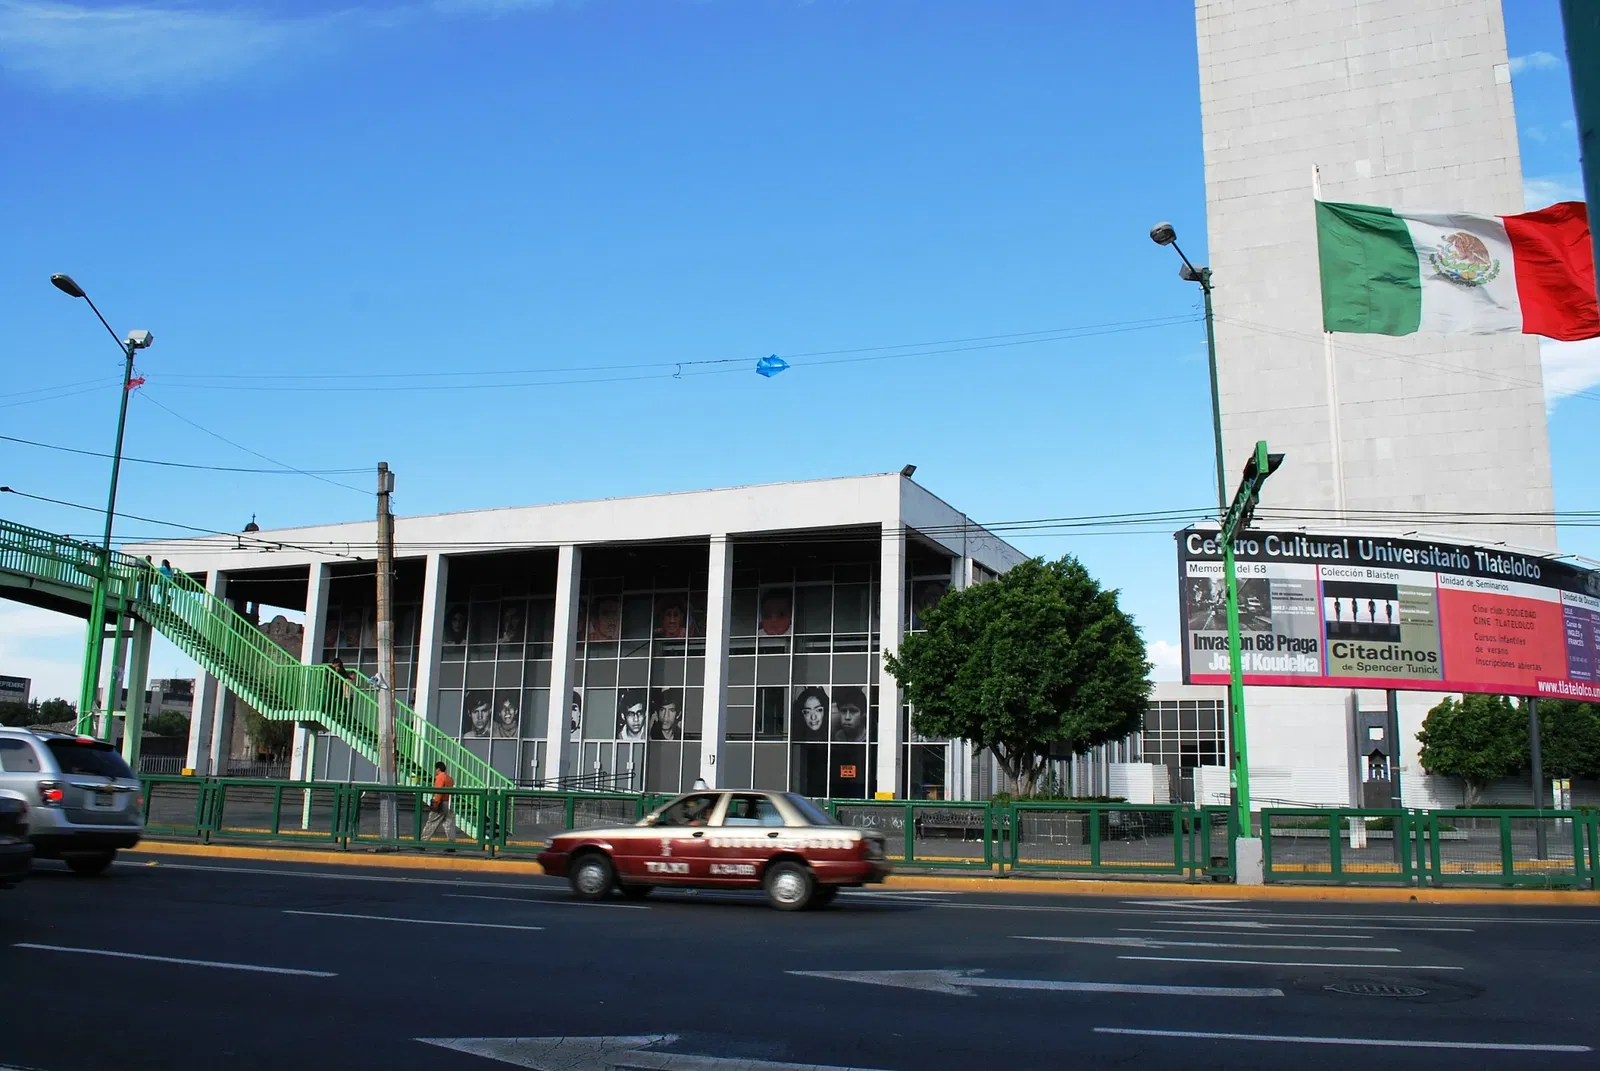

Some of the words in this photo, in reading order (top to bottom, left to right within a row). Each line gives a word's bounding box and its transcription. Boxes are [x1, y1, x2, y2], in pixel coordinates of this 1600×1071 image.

[1186, 533, 1259, 555] Cetro
[1265, 536, 1349, 559] Cultural
[1359, 539, 1470, 569] Universitario
[1475, 551, 1541, 579] Tlatelolco
[1237, 564, 1250, 573] del
[1254, 565, 1266, 573] 68
[1321, 567, 1363, 578] Colección
[1366, 569, 1399, 580] Blaisten
[1440, 575, 1464, 586] Unidad
[1466, 578, 1474, 587] de
[1476, 580, 1509, 591] Seminarios
[1472, 604, 1487, 613] Cine
[1506, 608, 1536, 619] SOCIEDAD
[1473, 616, 1491, 625] CINE
[1495, 618, 1534, 630] TLATELOLCO
[1193, 633, 1253, 651] Invasón
[1256, 634, 1274, 651] 68
[1277, 634, 1318, 654] Praga
[1474, 632, 1496, 642] Cursos
[1332, 642, 1437, 662] Citadinos
[1488, 647, 1508, 655] verano
[1252, 653, 1319, 673] Koudelka
[1342, 663, 1353, 671] de
[1356, 661, 1403, 673] Spencer
[1406, 663, 1439, 674] Tunick
[1476, 657, 1515, 668] Inscripciones
[1518, 661, 1542, 671] abiertas
[644, 861, 690, 874] TAXI
